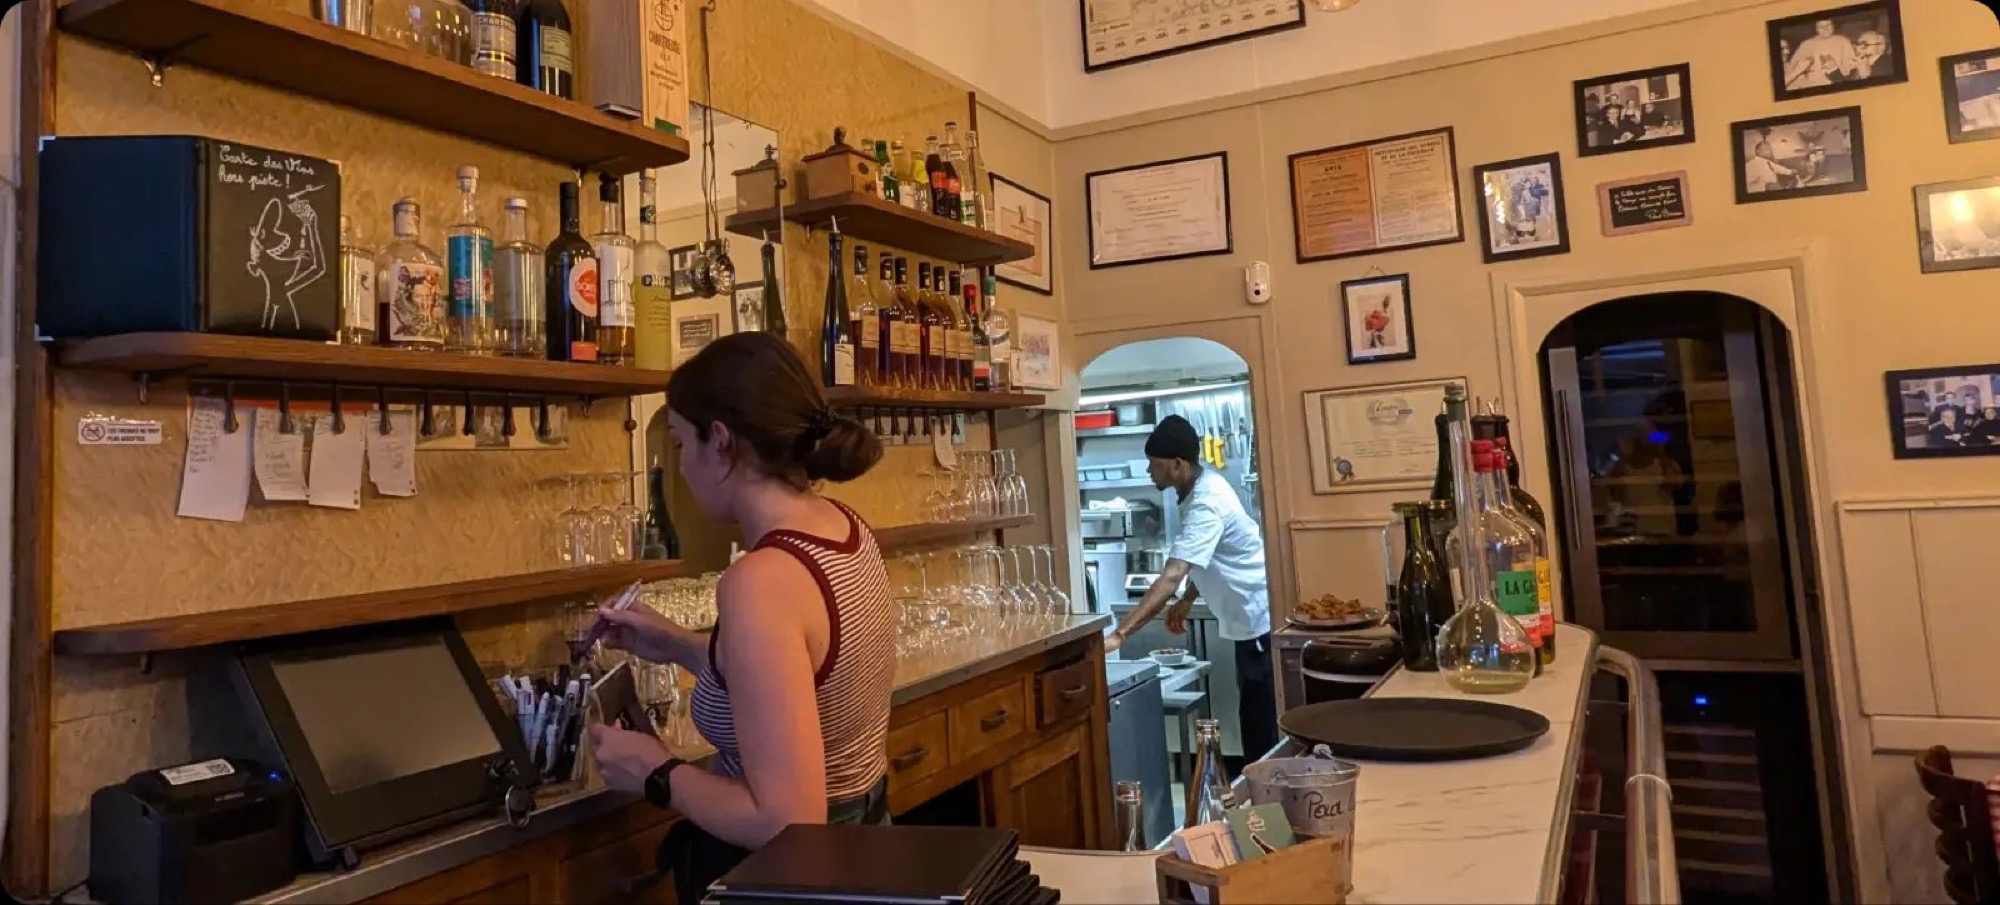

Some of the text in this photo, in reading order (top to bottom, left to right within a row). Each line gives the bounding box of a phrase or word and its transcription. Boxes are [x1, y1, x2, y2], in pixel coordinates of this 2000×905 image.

[219, 144, 315, 176] Carte des Vins
[218, 164, 244, 184] hors
[248, 172, 281, 191] piste
[1504, 580, 1520, 596] LA
